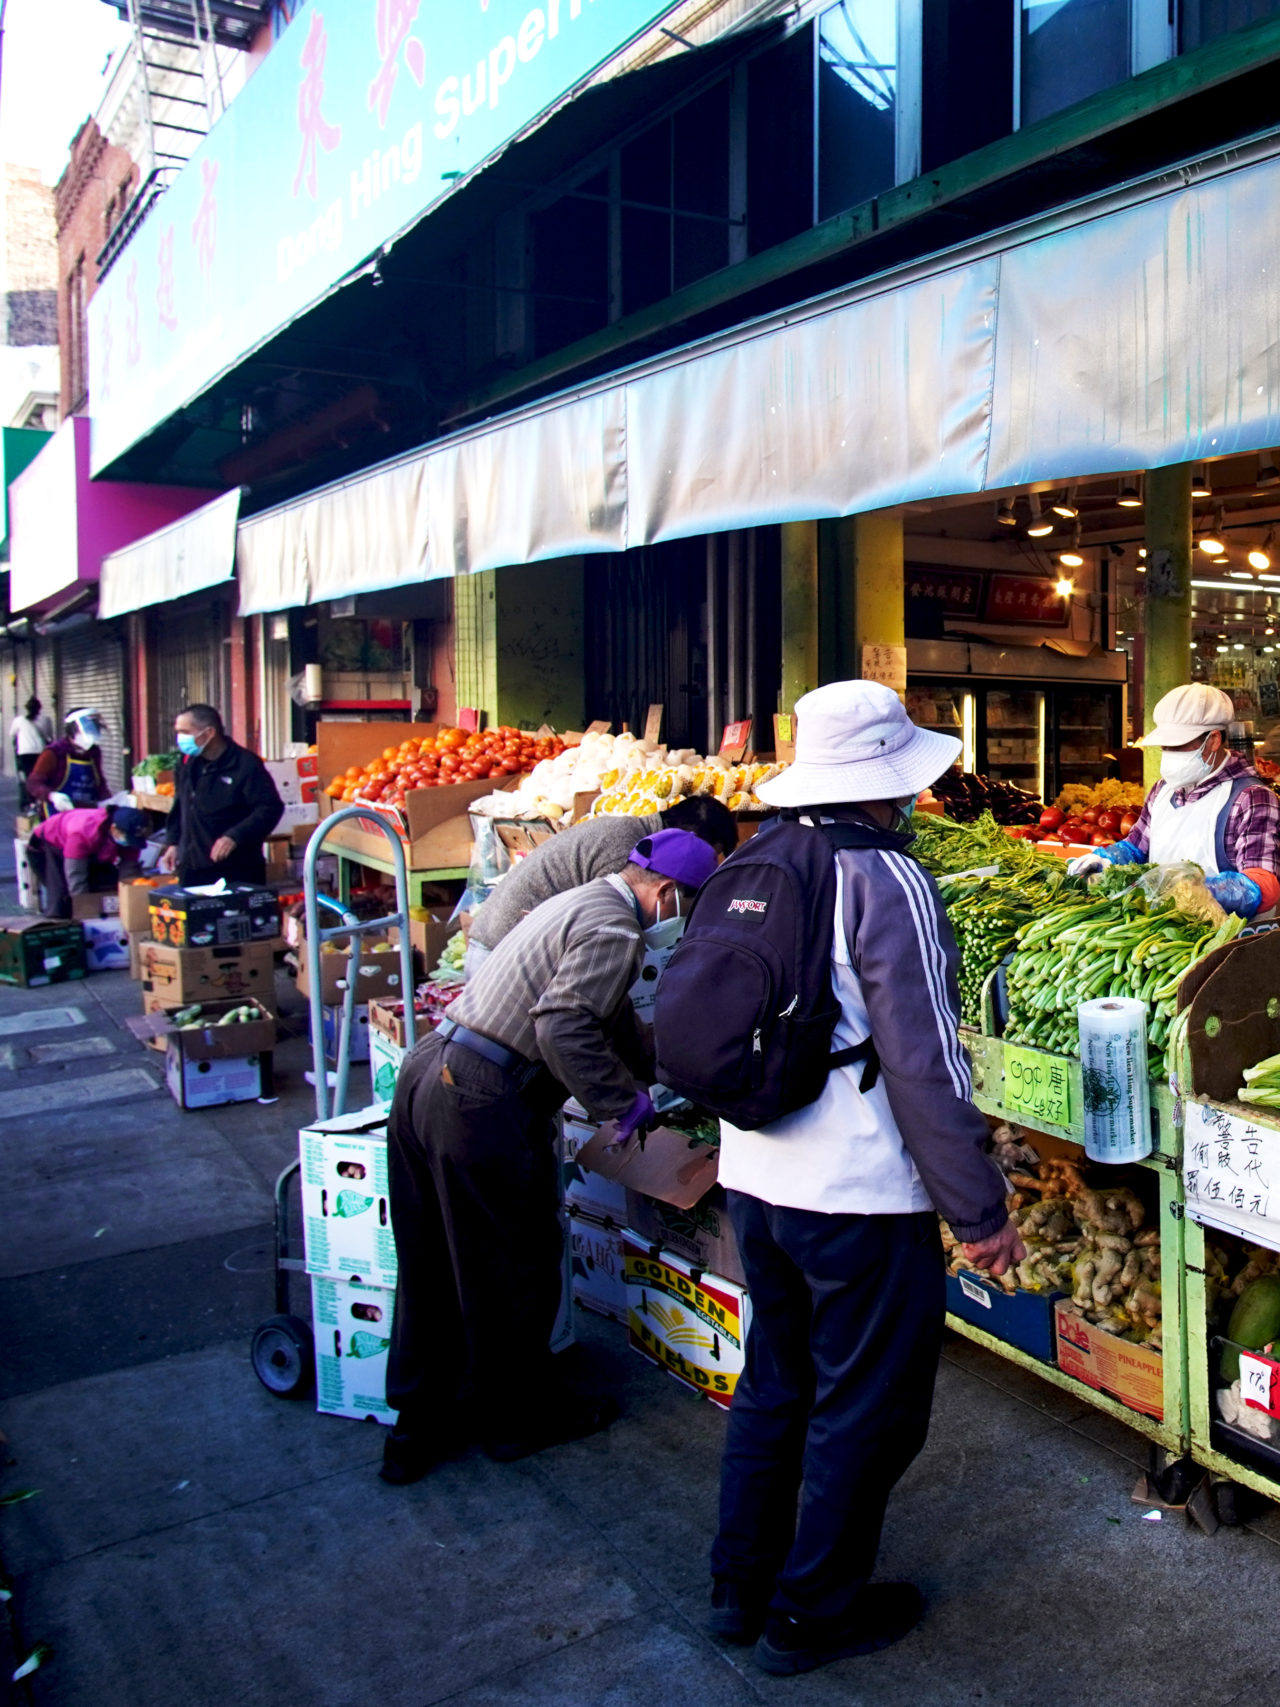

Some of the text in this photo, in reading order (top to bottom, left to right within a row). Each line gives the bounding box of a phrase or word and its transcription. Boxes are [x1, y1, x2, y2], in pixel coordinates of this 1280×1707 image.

[276, 199, 342, 283] Dong
[351, 121, 424, 219] Hing
[1105, 1041, 1113, 1057] New
[1126, 1074, 1134, 1095] Hing
[1127, 1095, 1136, 1145] Supermarket
[1212, 1114, 1264, 1156] 警告
[634, 1261, 726, 1324] GOLDEN
[695, 1305, 739, 1347] VEGETABLES
[1058, 1313, 1090, 1350] Dole
[641, 1329, 729, 1392] FIELDS
